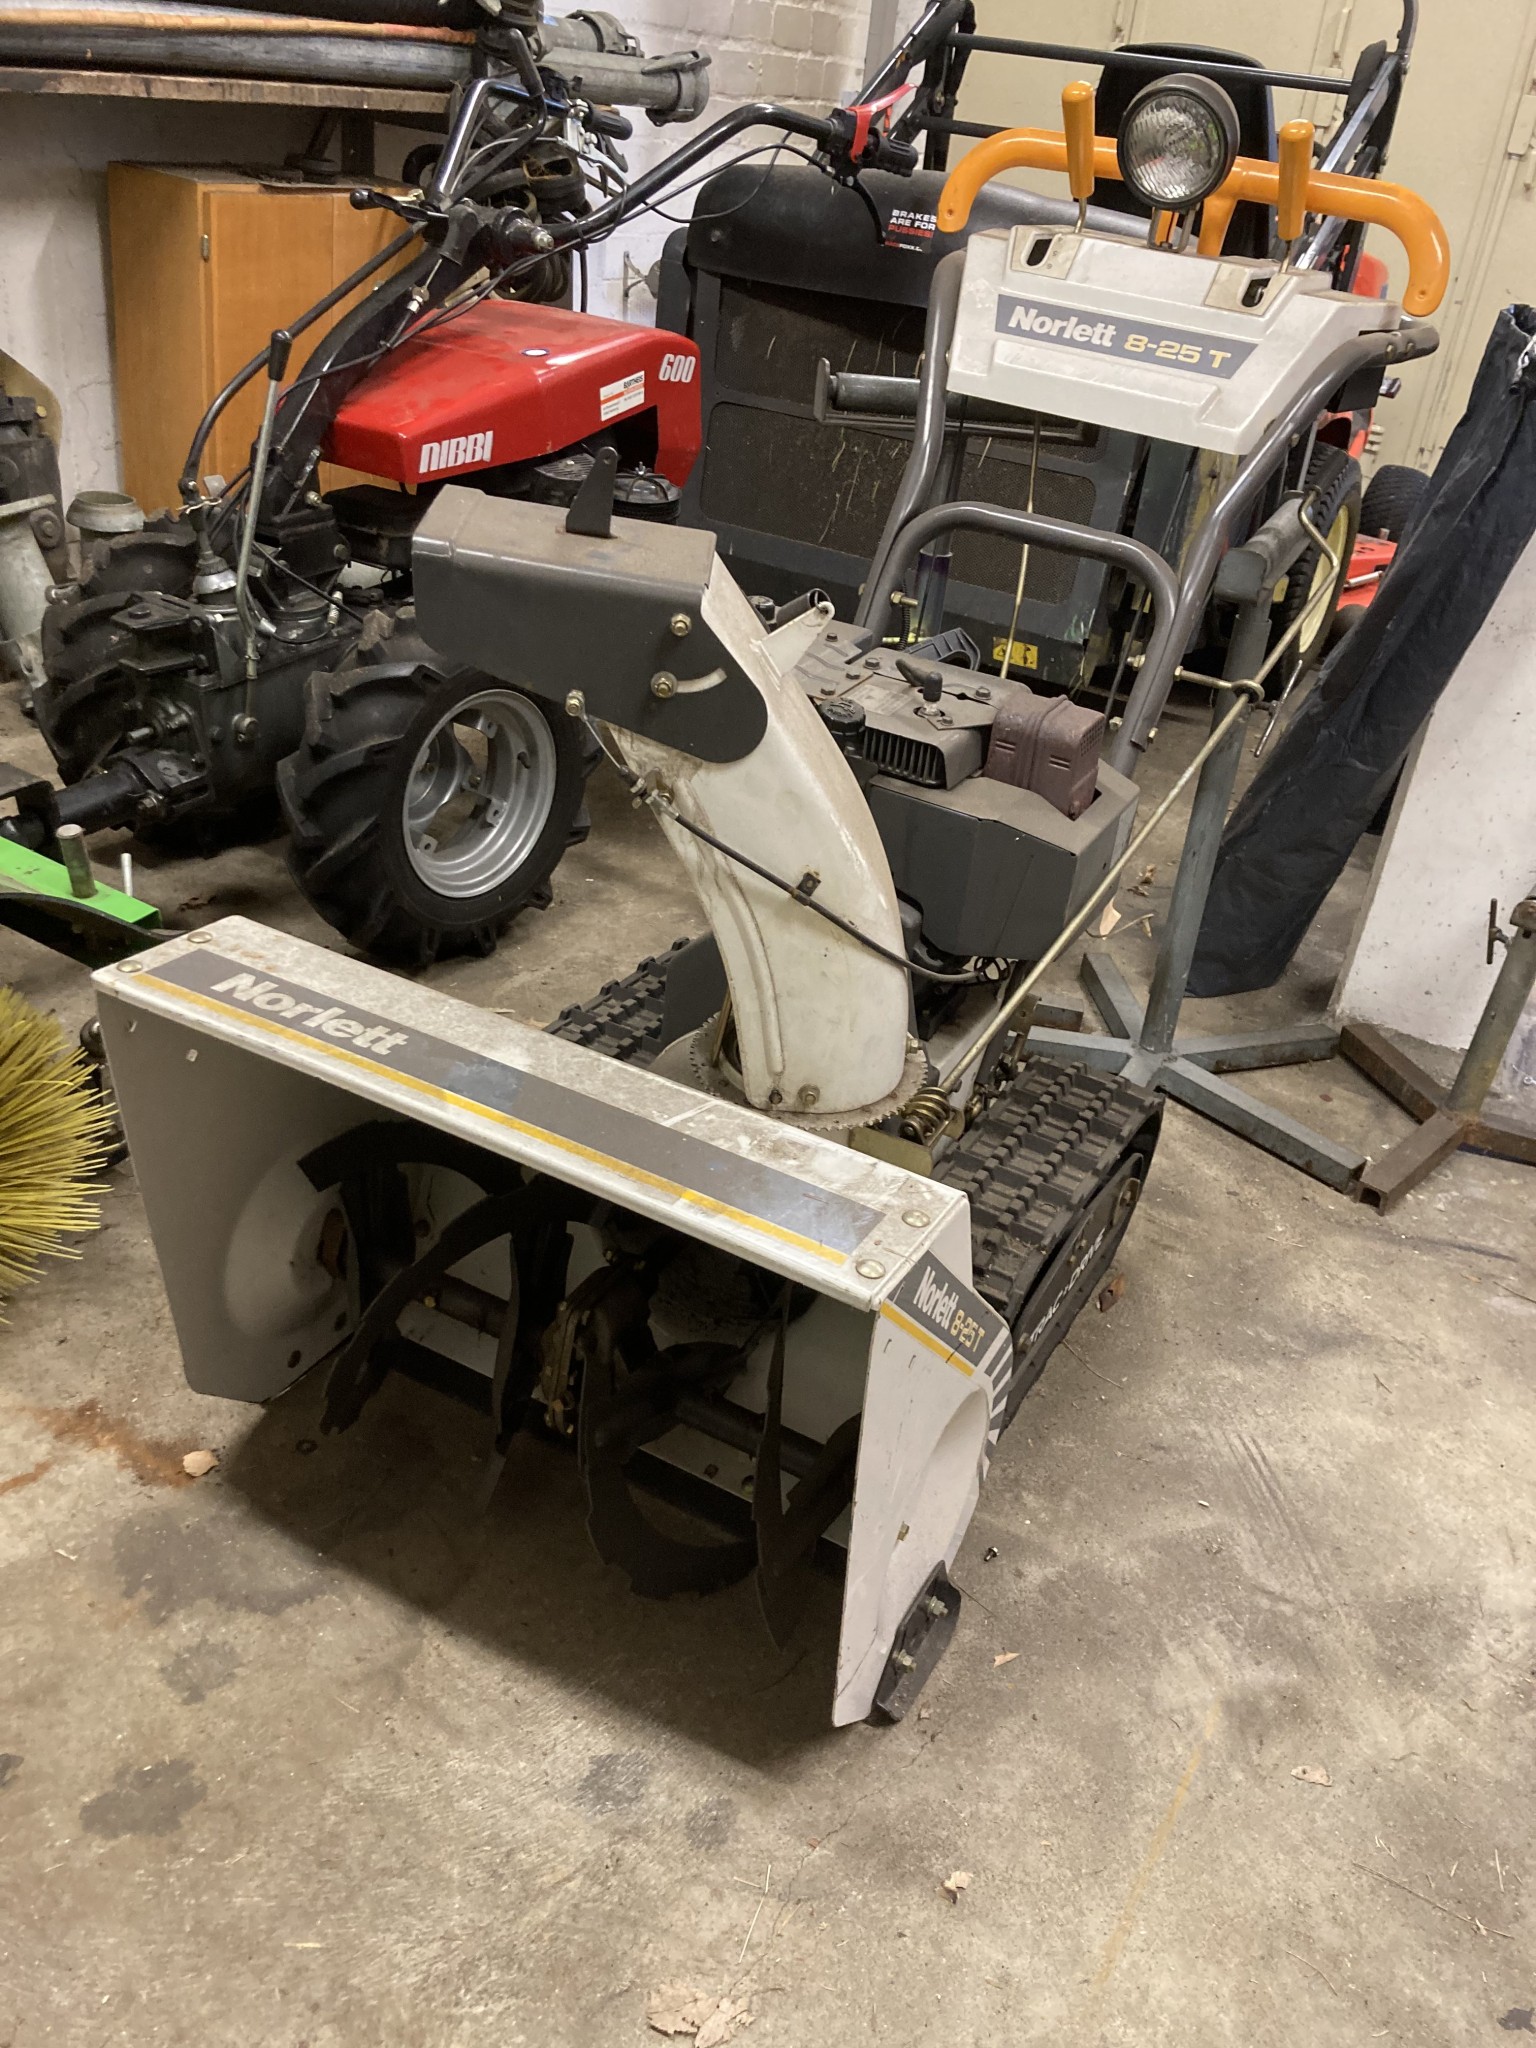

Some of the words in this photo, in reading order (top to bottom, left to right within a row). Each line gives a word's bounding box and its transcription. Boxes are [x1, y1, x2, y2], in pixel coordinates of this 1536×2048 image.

[890, 217, 912, 227] ARE
[914, 220, 936, 231] FOR
[892, 209, 937, 223] BRAKES
[1008, 305, 1116, 347] Norlett
[1123, 334, 1203, 364] 8-25
[1209, 349, 1231, 369] T
[658, 353, 696, 383] 600
[419, 431, 494, 473] NIBBI
[210, 972, 409, 1055] Norlett
[913, 1265, 959, 1330] Norlett
